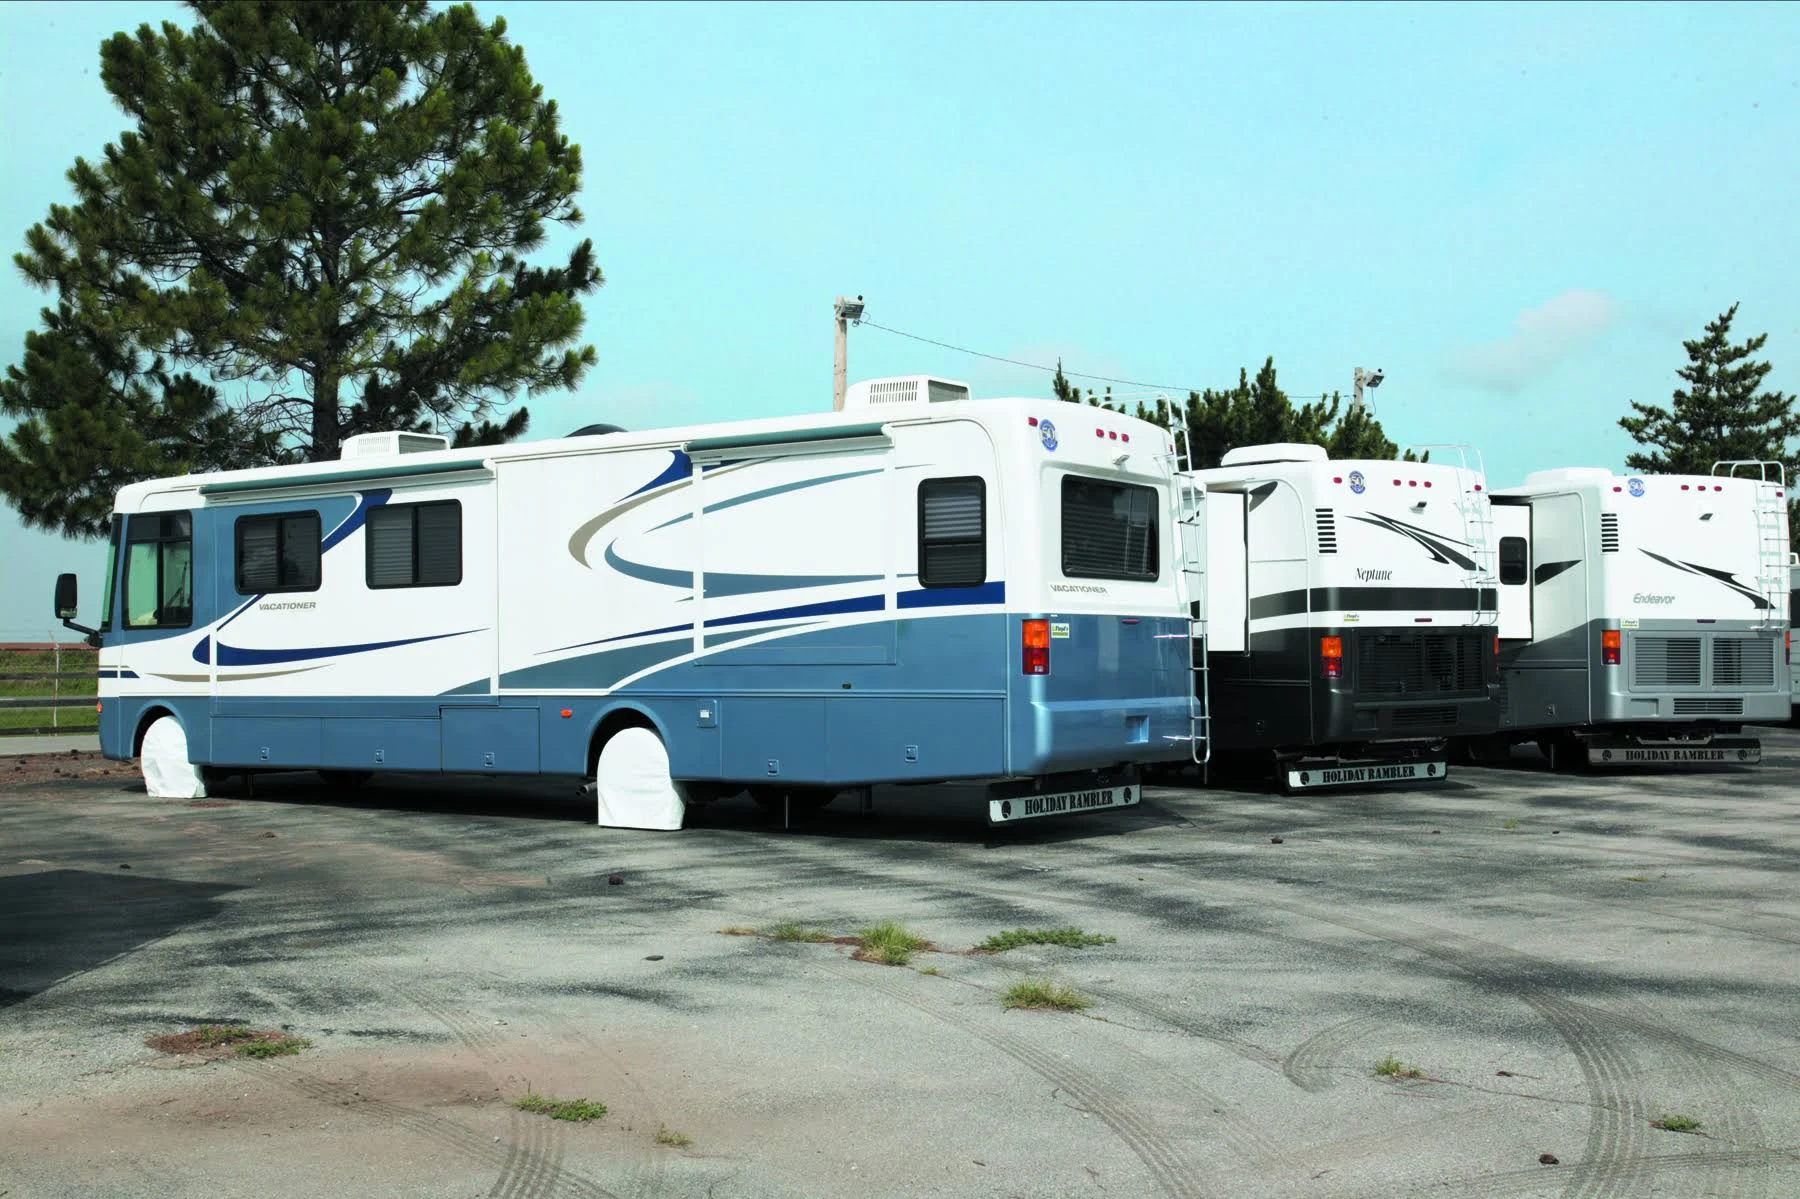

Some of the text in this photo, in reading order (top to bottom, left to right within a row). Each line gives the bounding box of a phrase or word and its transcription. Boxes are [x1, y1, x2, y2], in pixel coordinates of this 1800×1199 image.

[1354, 567, 1393, 583] Neptune
[1050, 584, 1108, 595] VACATIONER
[1633, 592, 1676, 605] Endeavor
[259, 601, 317, 611] VACATIONER
[1625, 750, 1724, 761] HOLIDAY RAMBLER
[1322, 765, 1416, 783] HOLIDAY RAMBLER
[1024, 790, 1113, 815] HOLIDAY RAMBLER
